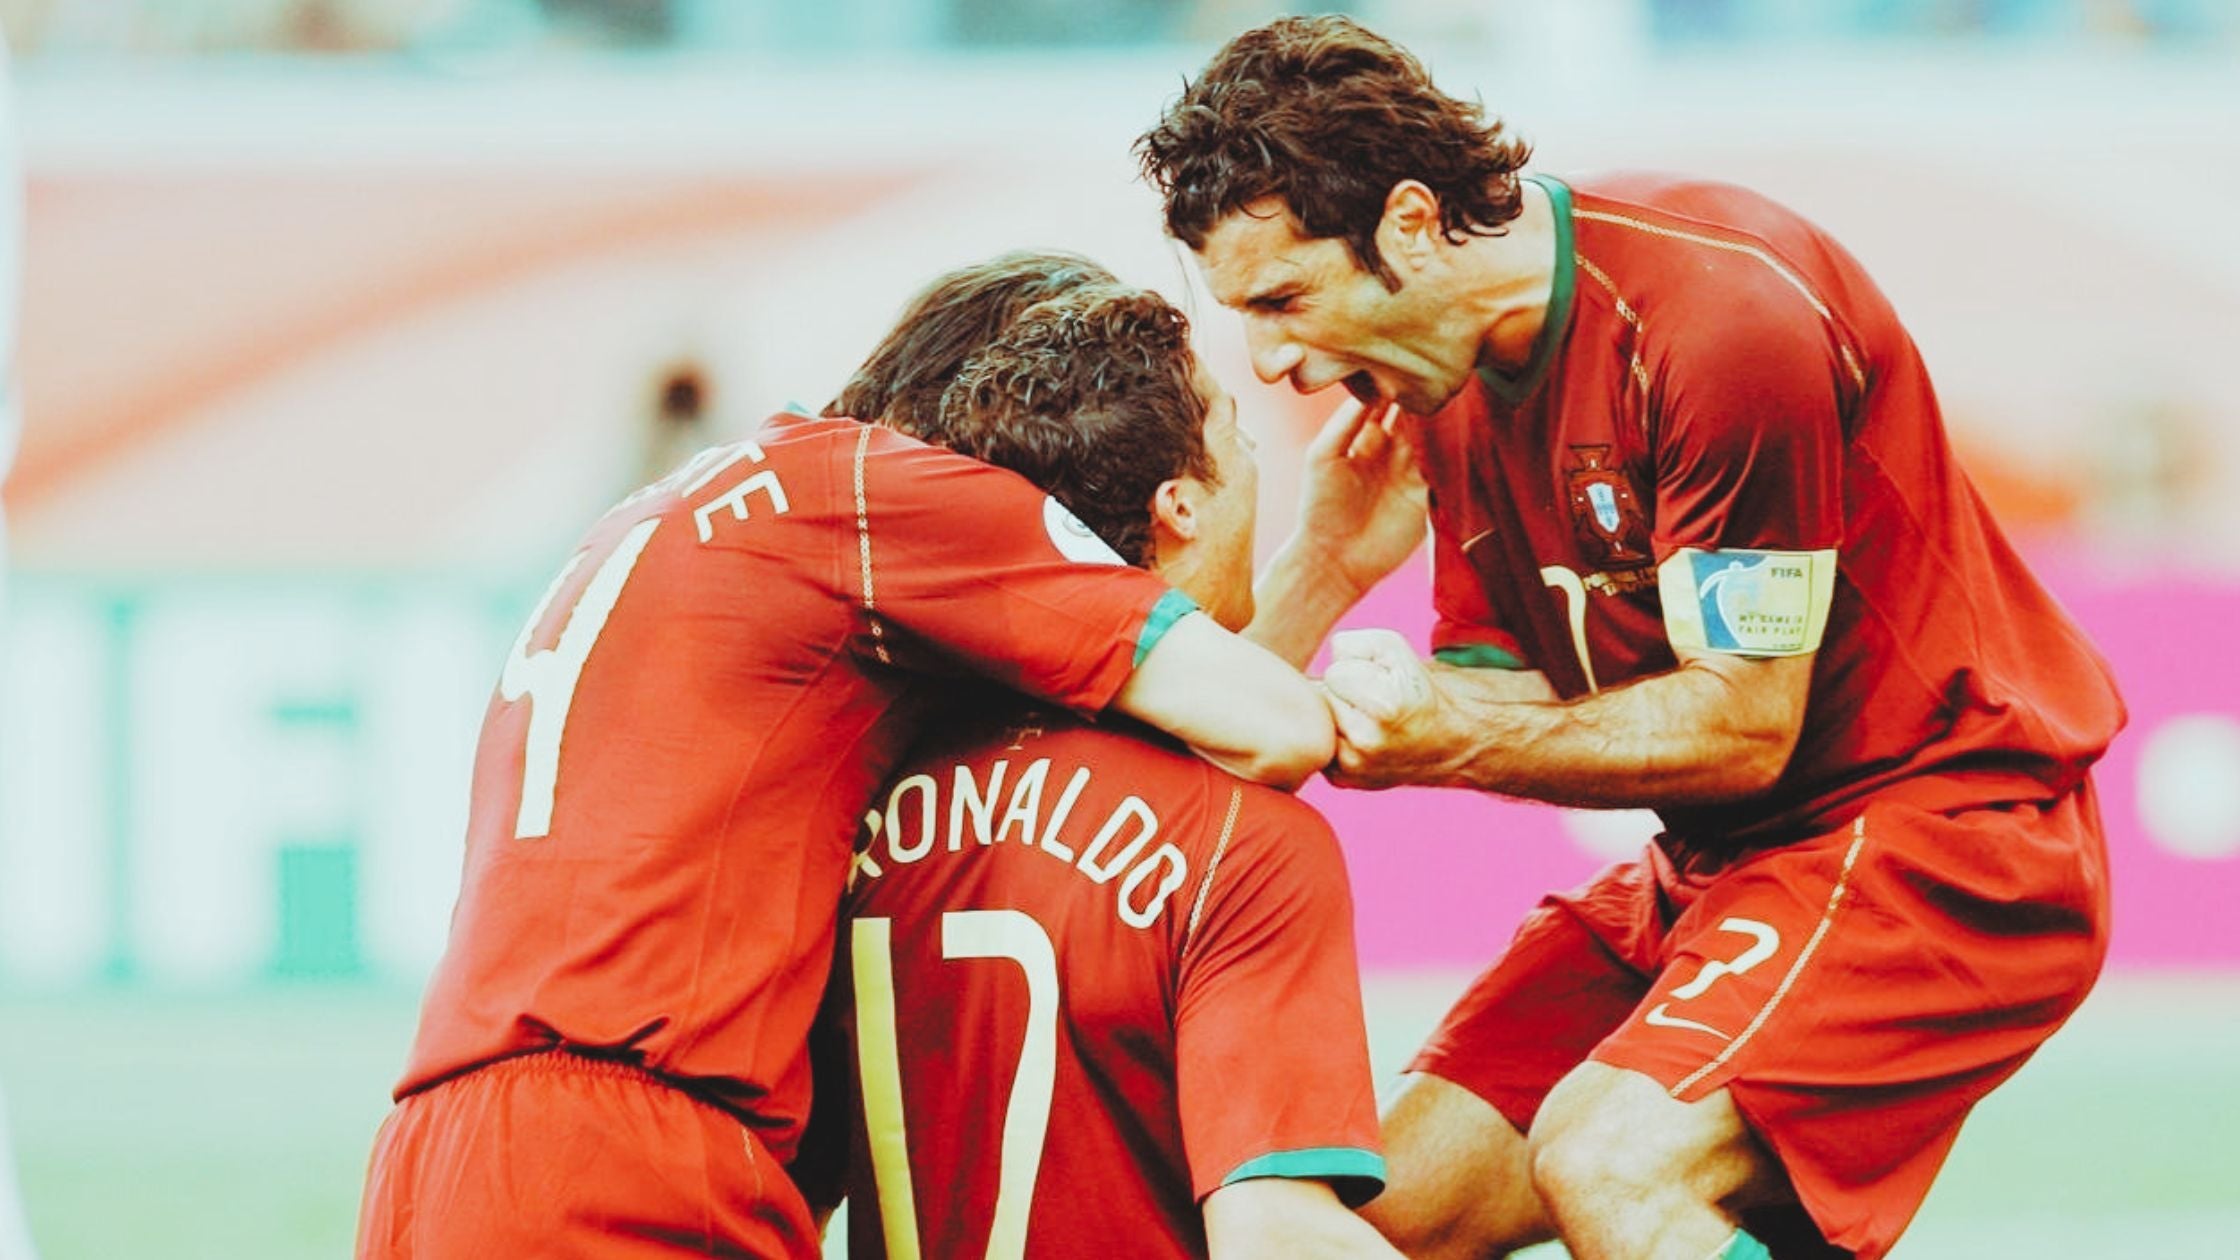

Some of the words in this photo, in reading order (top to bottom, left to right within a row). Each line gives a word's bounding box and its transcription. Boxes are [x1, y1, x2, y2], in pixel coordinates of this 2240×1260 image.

[1770, 567, 1803, 578] FIFA
[1738, 624, 1767, 635] FAIR
[1773, 625, 1802, 636] PLAY
[848, 758, 1187, 930] RONALDO
[1669, 917, 1780, 1001] 7
[852, 909, 1060, 1260] 17
